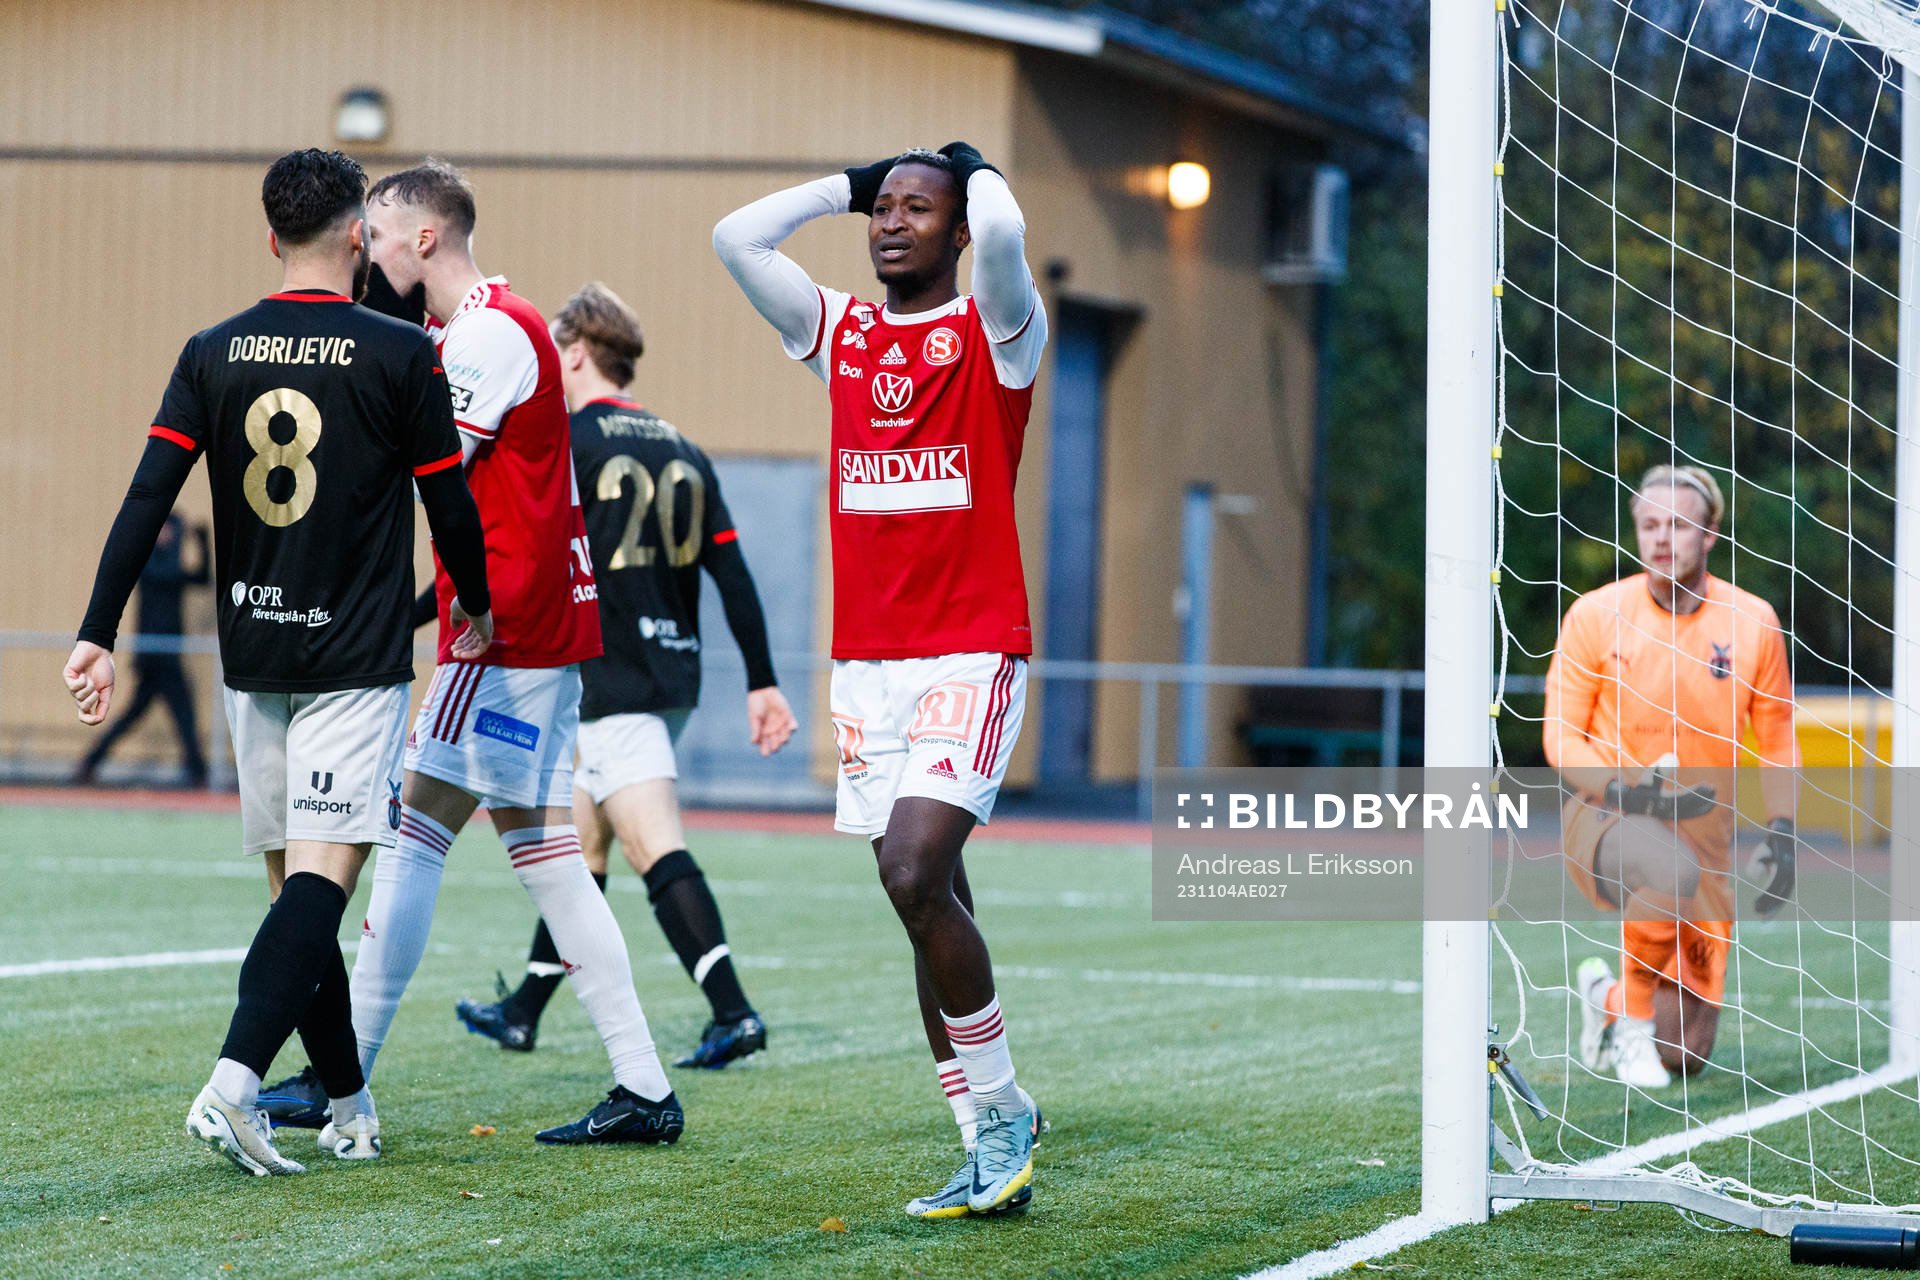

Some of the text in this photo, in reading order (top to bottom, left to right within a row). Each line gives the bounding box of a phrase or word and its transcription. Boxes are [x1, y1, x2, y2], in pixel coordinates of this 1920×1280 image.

[228, 335, 355, 366] DOBRIJEVIC
[879, 357, 907, 365] adidas
[243, 387, 323, 528] 8
[841, 449, 965, 483] SANDVIK
[597, 454, 706, 571] 20
[248, 585, 283, 607] OPR
[252, 607, 332, 627] Företagslån Flex
[926, 768, 958, 781] adidas
[293, 796, 351, 815] unisport
